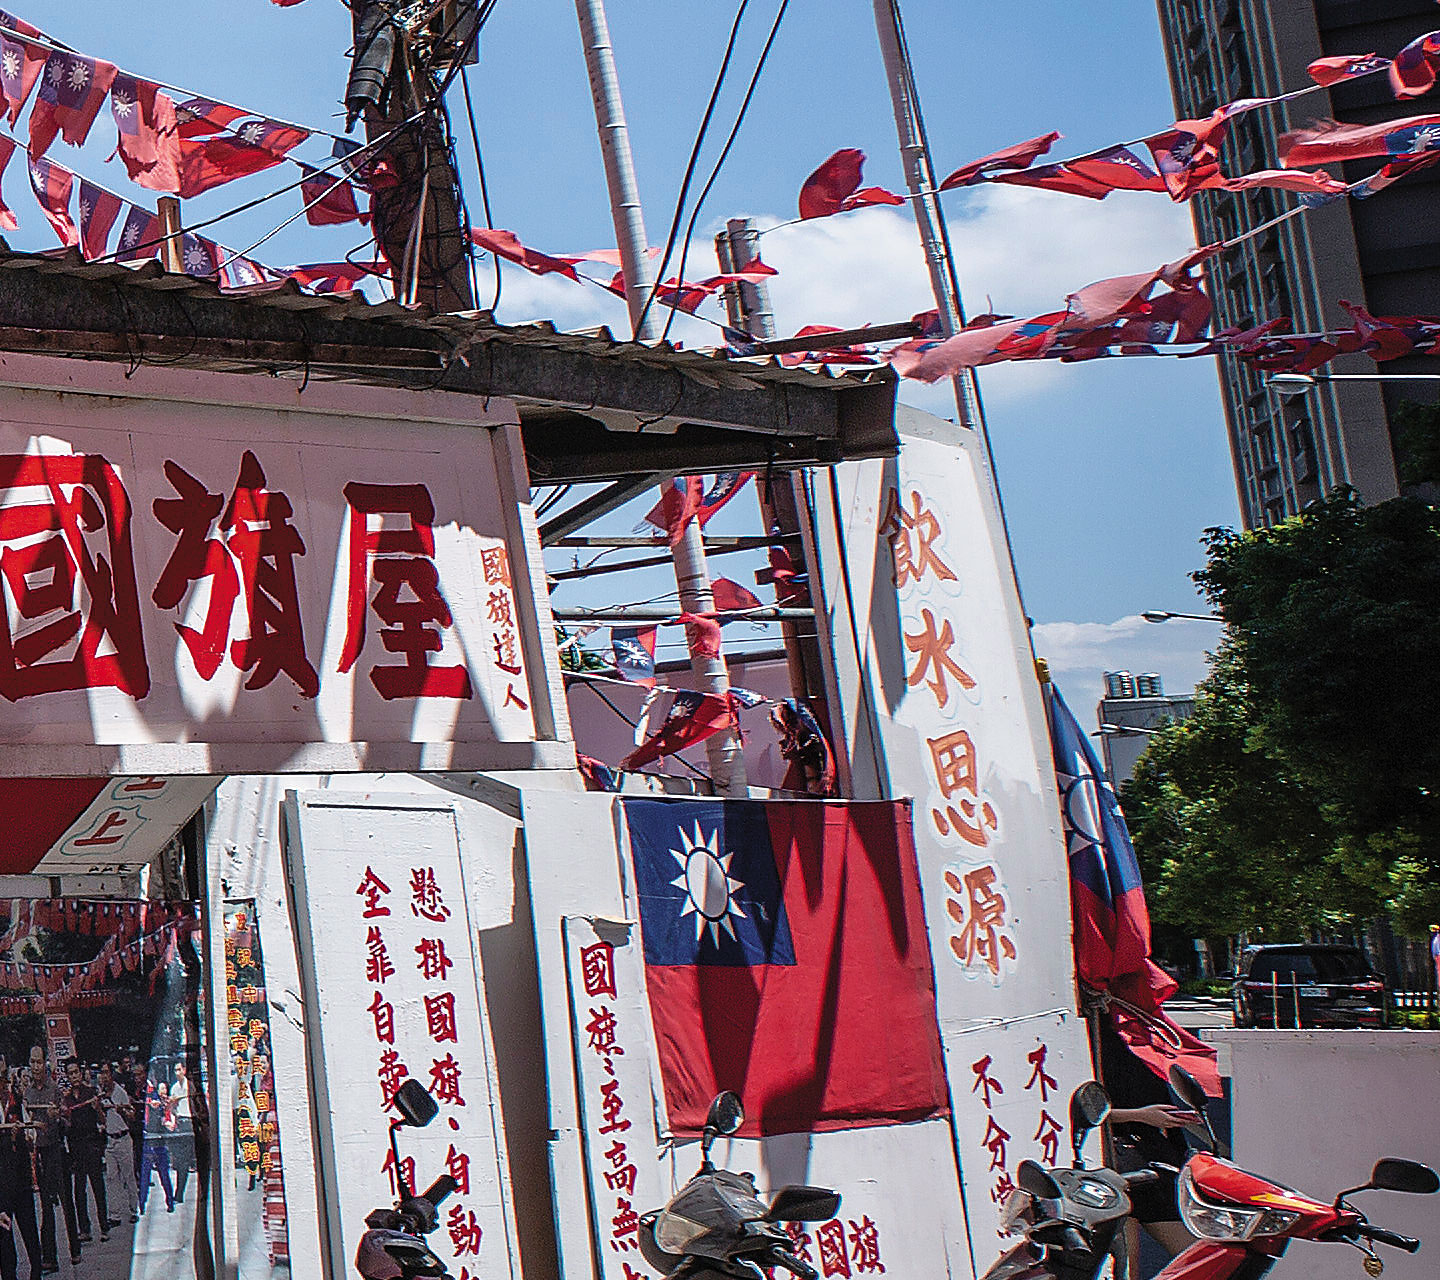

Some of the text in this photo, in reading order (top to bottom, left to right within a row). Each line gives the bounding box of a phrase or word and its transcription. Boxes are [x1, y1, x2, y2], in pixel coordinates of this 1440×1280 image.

[480, 546, 529, 711] 國旗達人
[878, 485, 1017, 975] 飲水思源
